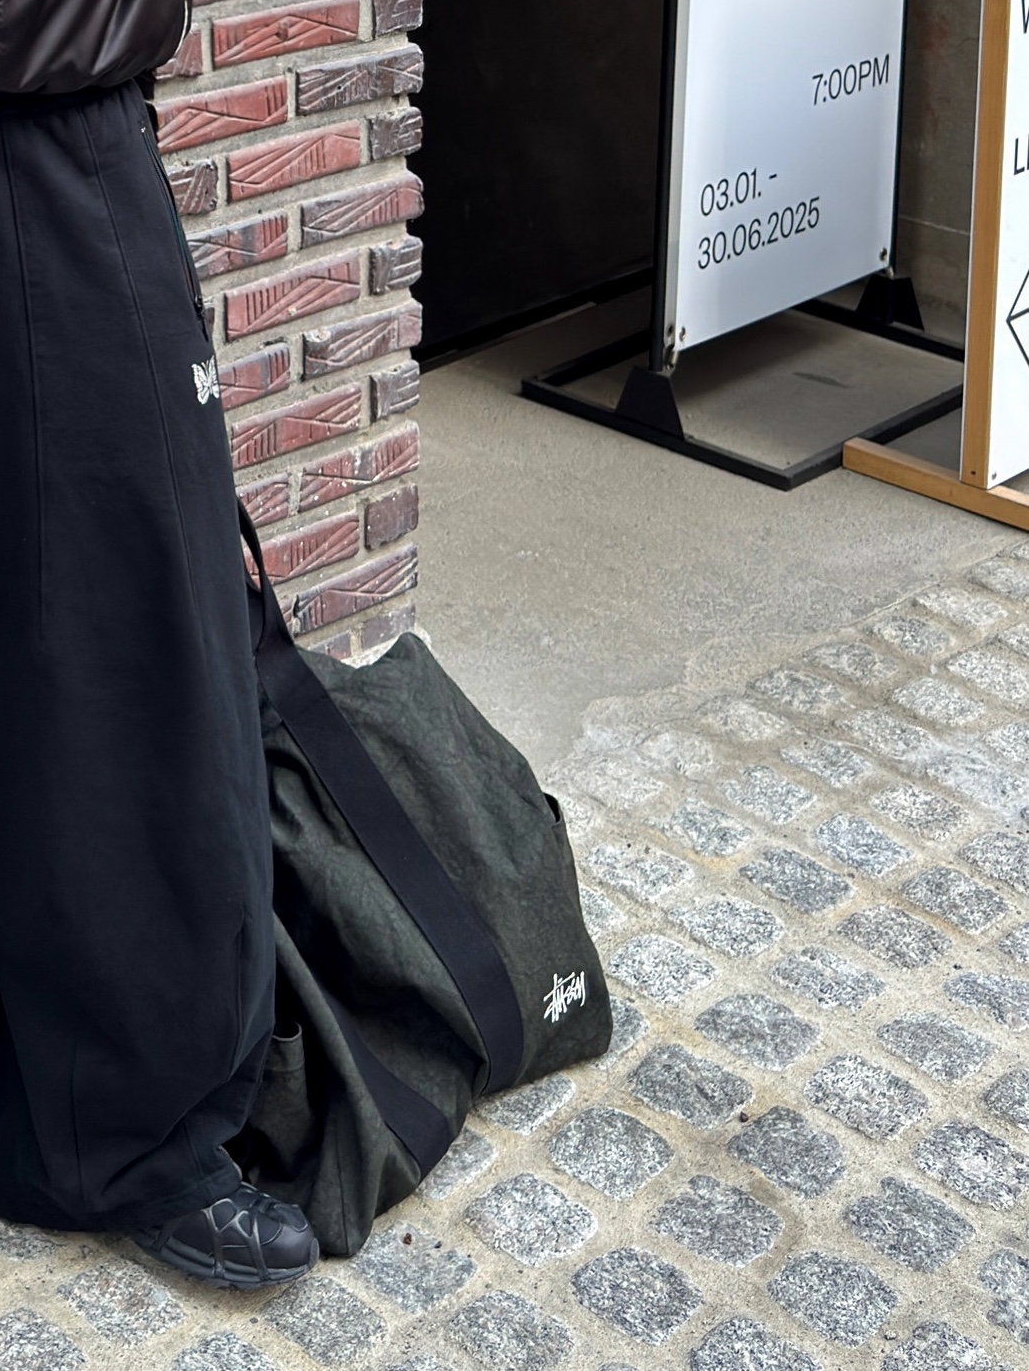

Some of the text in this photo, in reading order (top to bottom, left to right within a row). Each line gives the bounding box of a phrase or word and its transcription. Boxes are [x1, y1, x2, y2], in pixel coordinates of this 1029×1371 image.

[812, 54, 890, 106] 7:00PM
[700, 168, 762, 217] 03.01.
[697, 197, 820, 270] 30.06.2025
